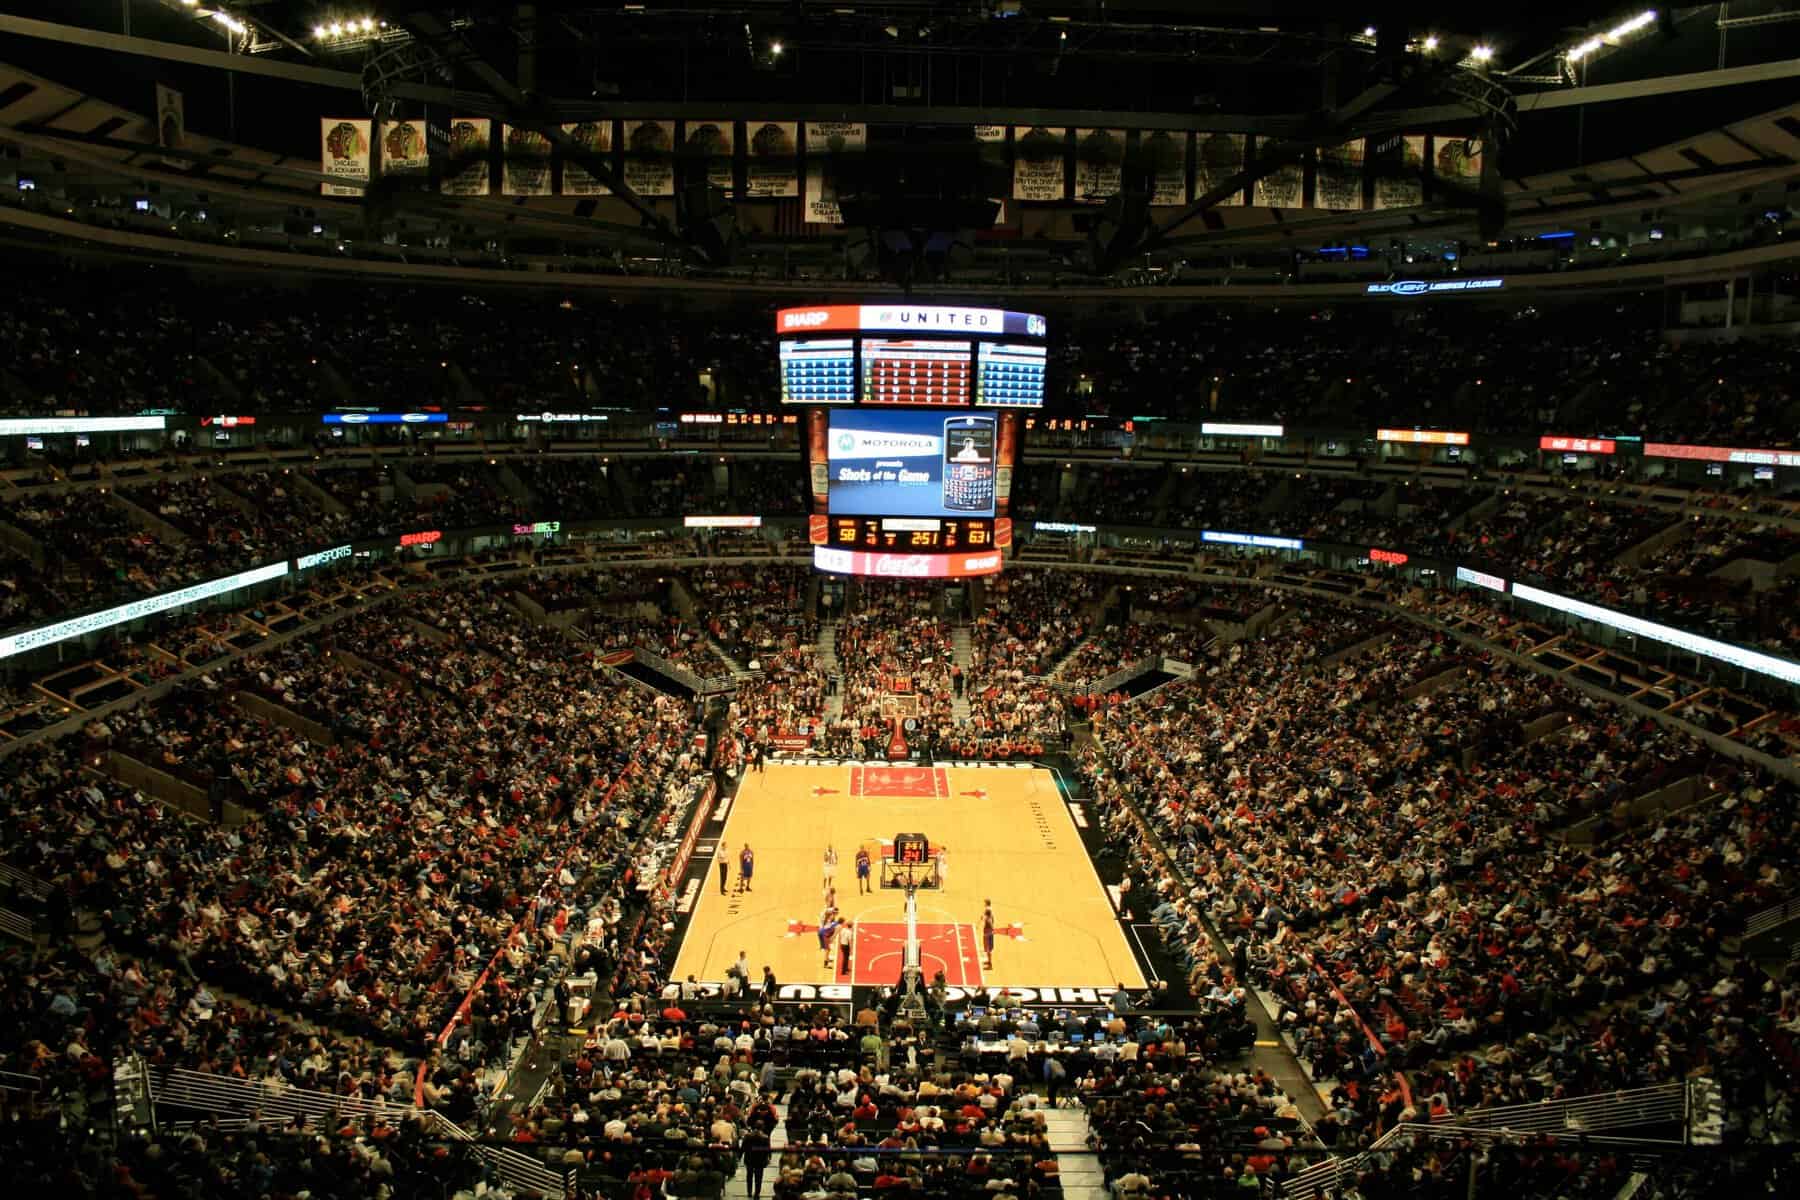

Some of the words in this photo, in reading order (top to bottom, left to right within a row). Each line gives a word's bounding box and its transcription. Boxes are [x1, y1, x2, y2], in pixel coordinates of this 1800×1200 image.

[784, 311, 829, 327] SHARP
[901, 312, 988, 325] UNITED
[862, 439, 933, 448] MOTOROLA
[839, 468, 872, 481] Shots
[872, 470, 882, 480] of
[883, 471, 896, 480] the
[898, 469, 930, 482] Game
[400, 531, 443, 546] SHARP
[839, 529, 856, 541] 58
[1369, 548, 1408, 565] SHARP
